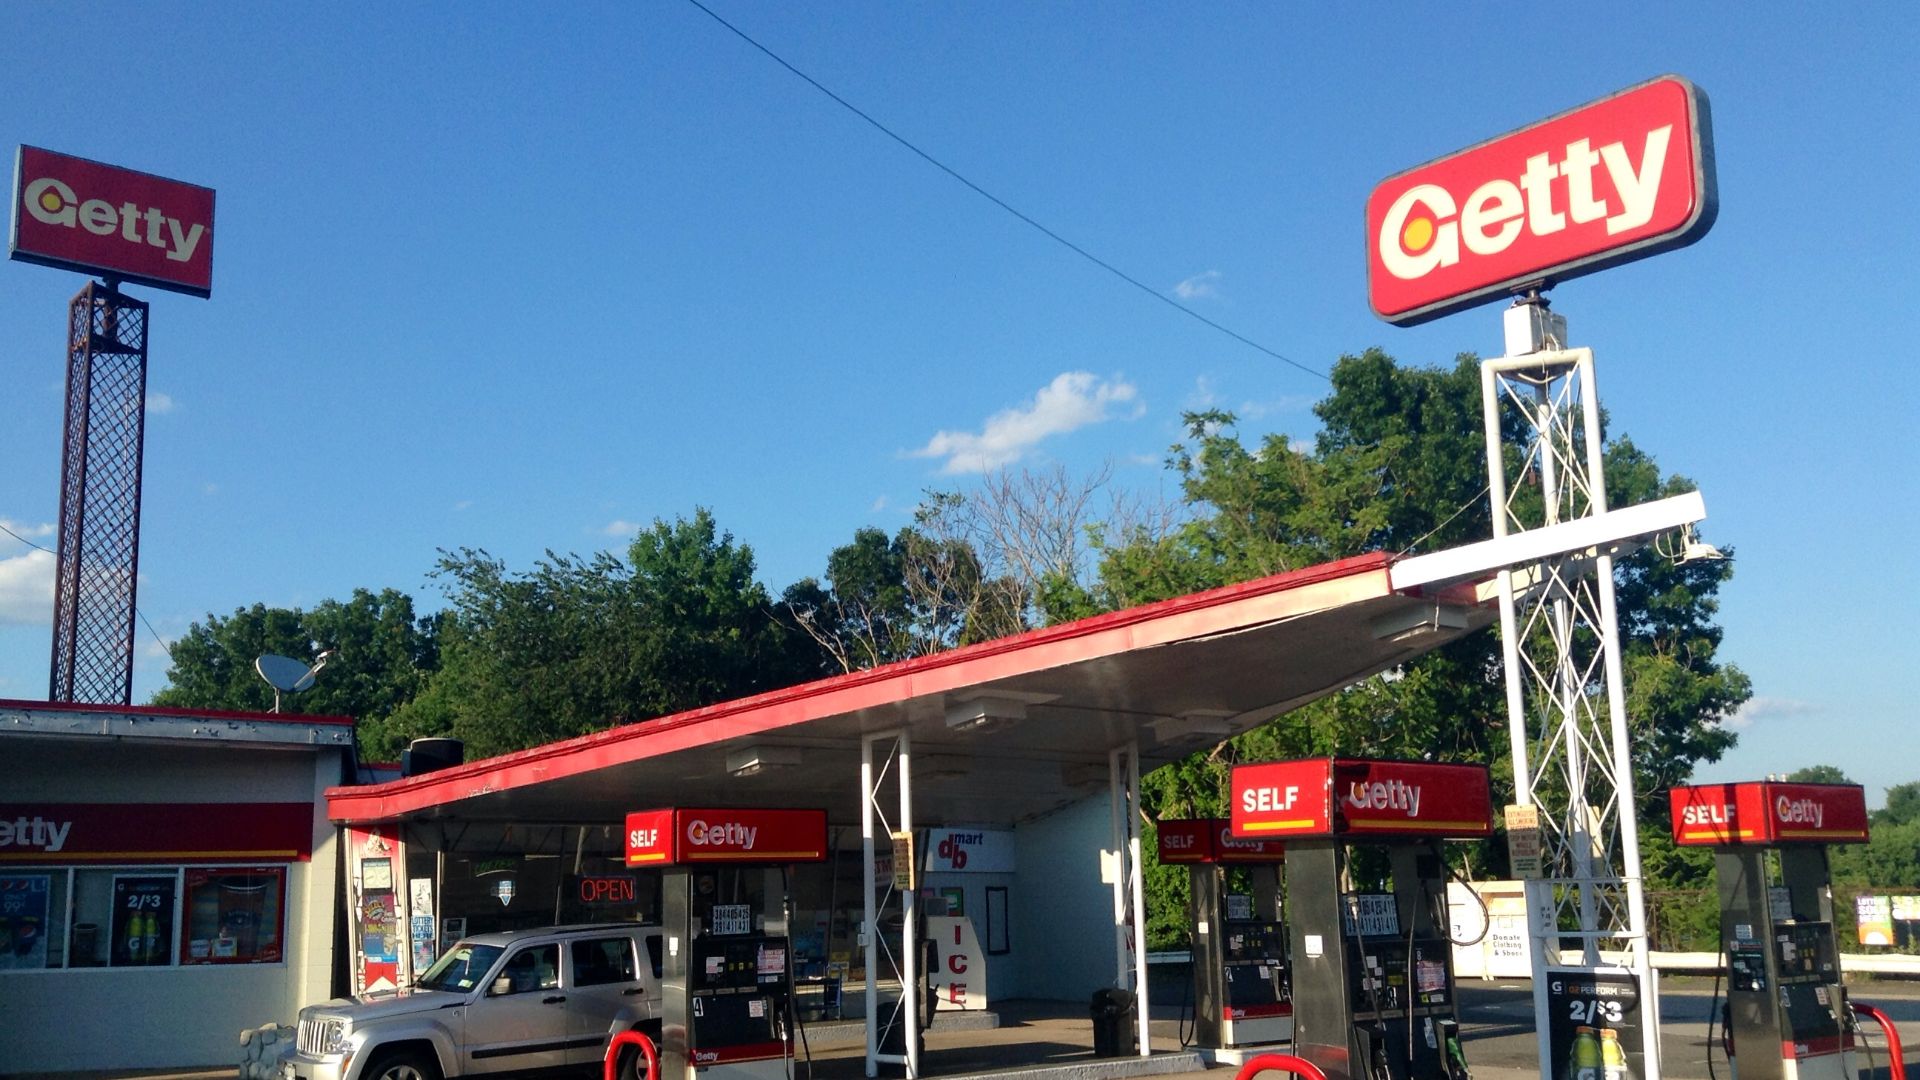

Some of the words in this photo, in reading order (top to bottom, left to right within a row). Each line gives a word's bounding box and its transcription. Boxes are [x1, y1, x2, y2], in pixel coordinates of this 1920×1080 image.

[1379, 124, 1673, 279] Getty
[24, 177, 204, 262] Getty
[1242, 786, 1299, 812] SELF
[1350, 779, 1420, 817] Getty
[1682, 804, 1736, 825] SELF
[1777, 795, 1823, 828] Getty
[630, 828, 658, 848] SELF
[687, 820, 757, 849] Getty
[954, 832, 984, 845] mart
[1163, 834, 1194, 849] SELF
[875, 859, 892, 873] TM
[581, 879, 634, 901] OPEN
[128, 894, 161, 910] 2/$3
[412, 916, 433, 924] LOTTERY
[1492, 941, 1522, 949] Clothing
[949, 925, 967, 1004] ICE
[1552, 981, 1562, 991] G
[1581, 986, 1618, 995] PERFORM
[1569, 1000, 1623, 1024] 2/$3
[695, 1052, 719, 1062] Getty
